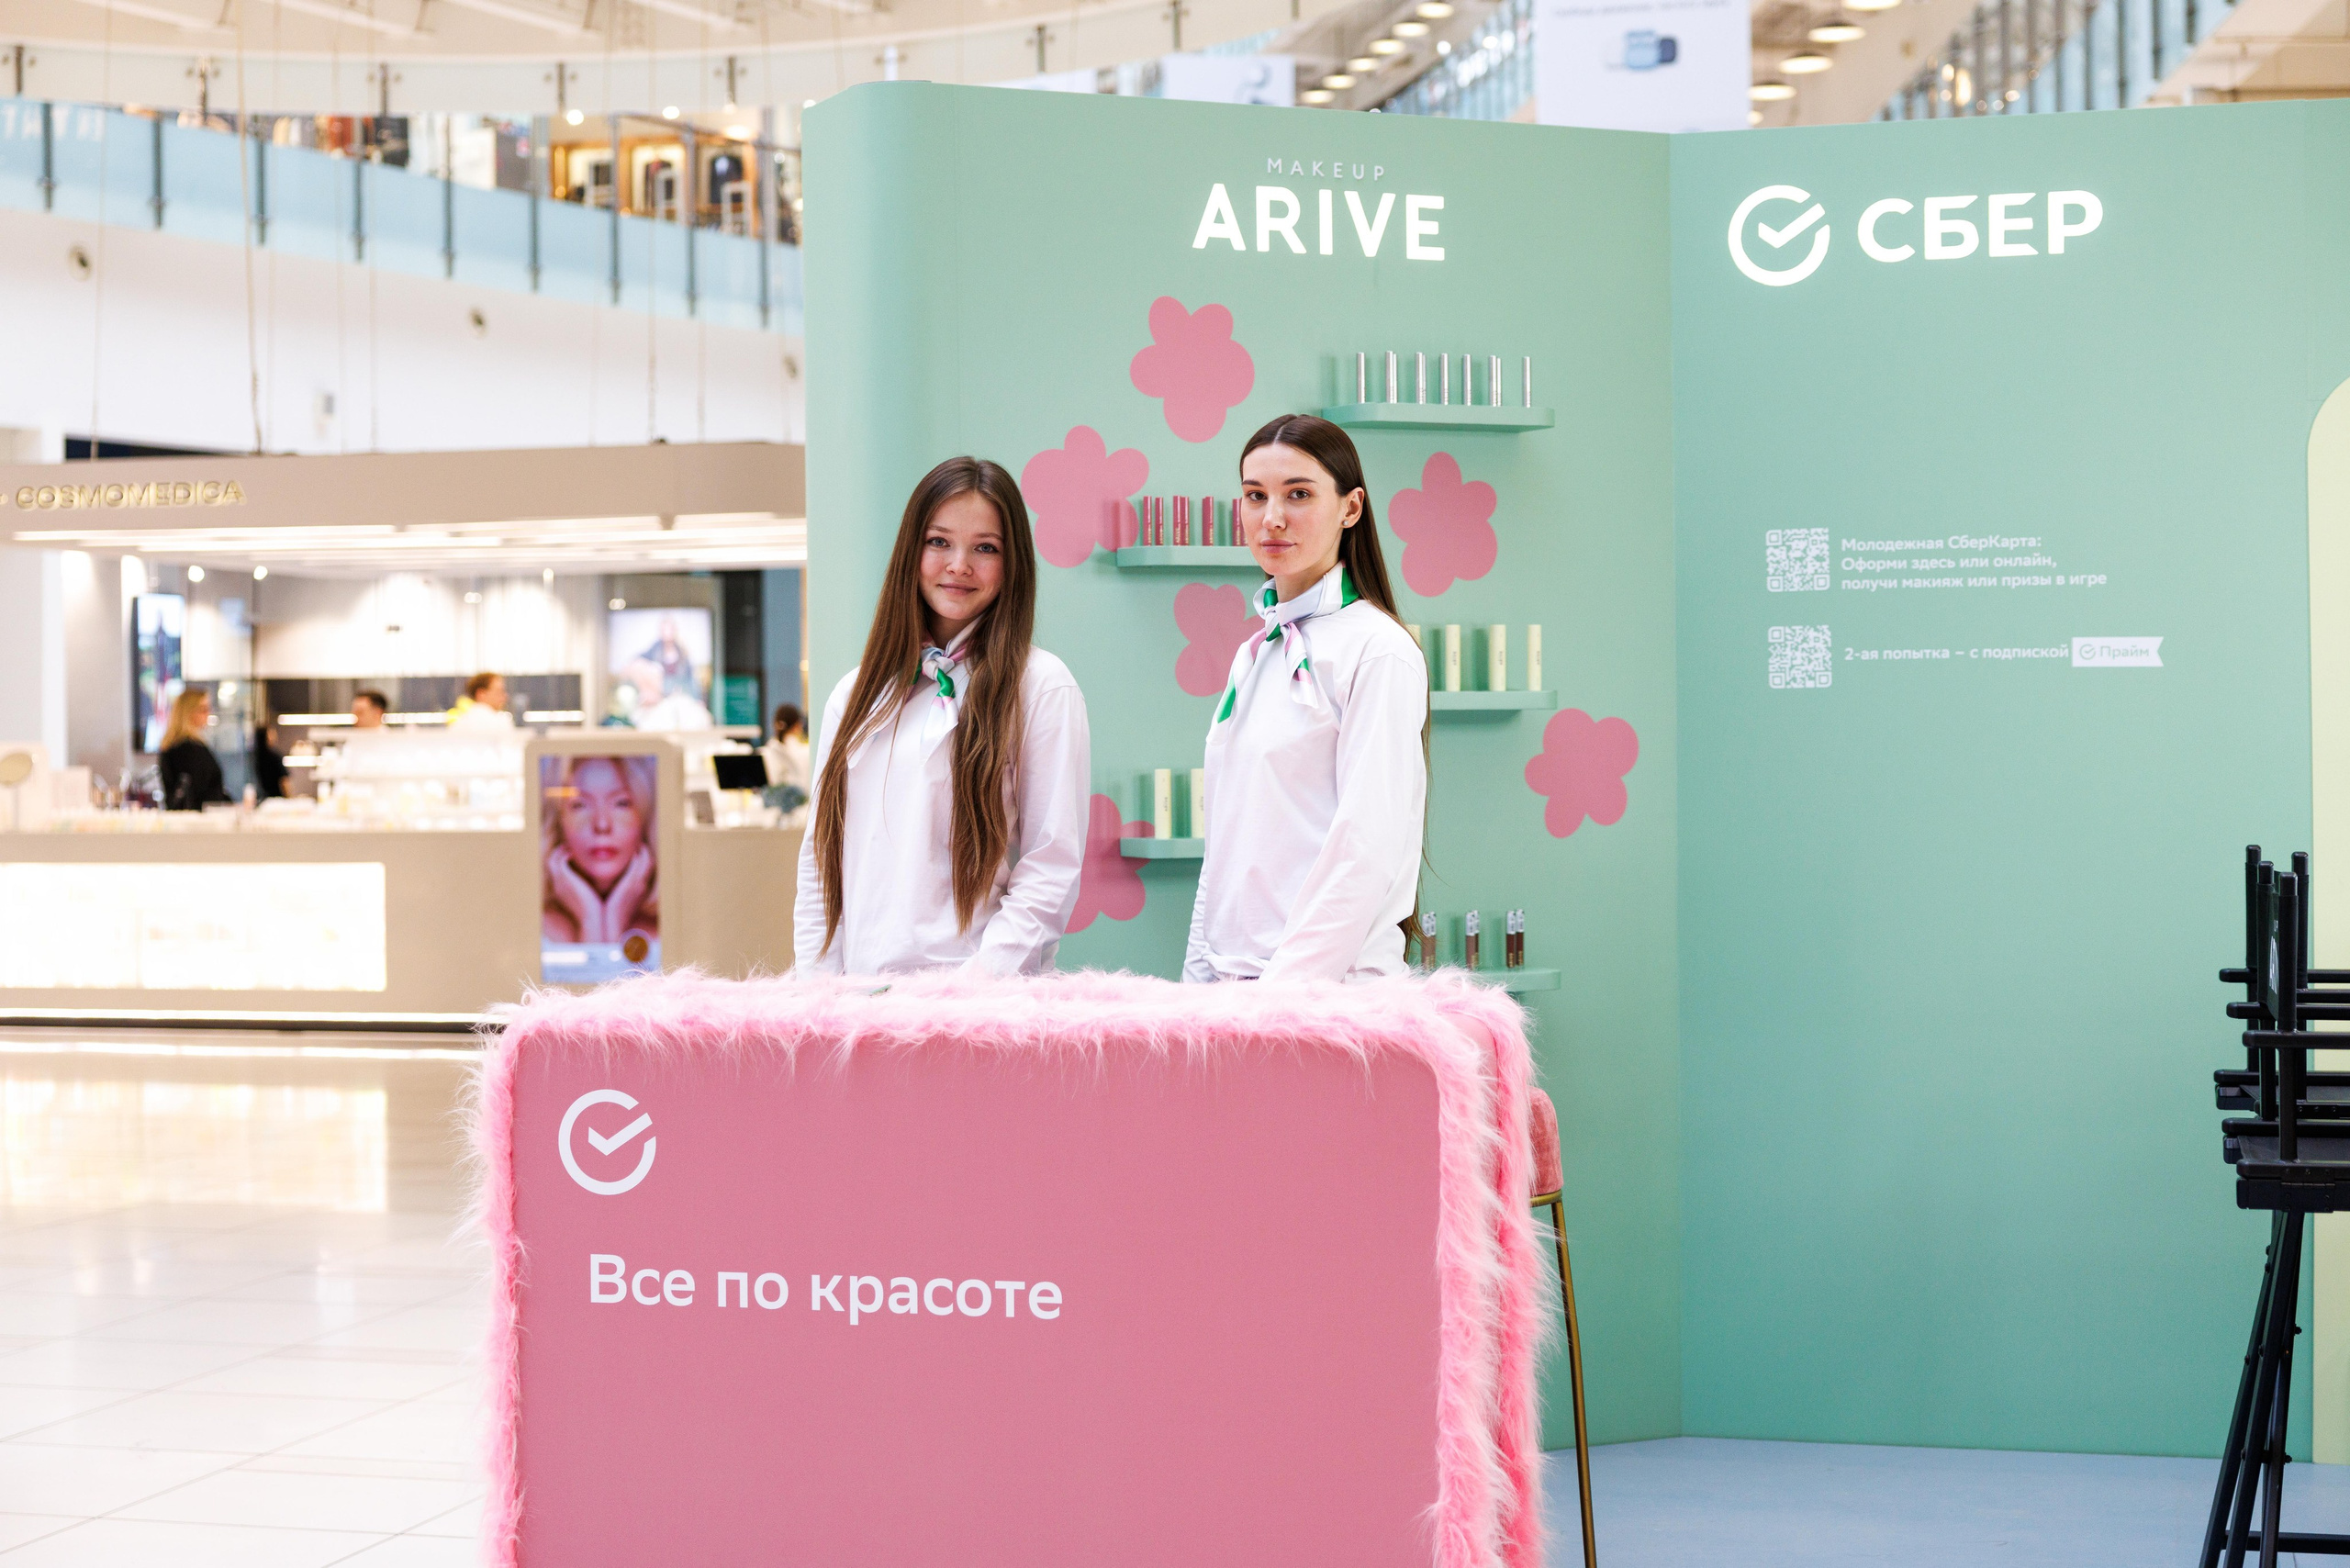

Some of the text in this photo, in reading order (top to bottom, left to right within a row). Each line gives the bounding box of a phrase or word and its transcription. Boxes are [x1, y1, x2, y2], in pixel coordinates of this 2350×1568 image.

[1267, 157, 1385, 181] MAKEUP
[1192, 183, 1446, 261] ARIVE
[1857, 190, 2103, 263] СБЕР
[17, 480, 247, 511] COSMOMEDICA
[1841, 534, 2042, 552] Молодежная СберКарта:
[1841, 552, 2057, 573] Оформи здесь или онлайн,
[1841, 574, 2108, 592] получи макияж или призы в игре
[1844, 647, 1879, 661] 2-ая
[1883, 648, 1950, 660] попытка
[1970, 648, 1979, 658] с
[1982, 644, 2069, 660] подпиской
[2099, 644, 2150, 660] Прайм
[589, 1254, 1063, 1326] Все по красоте
